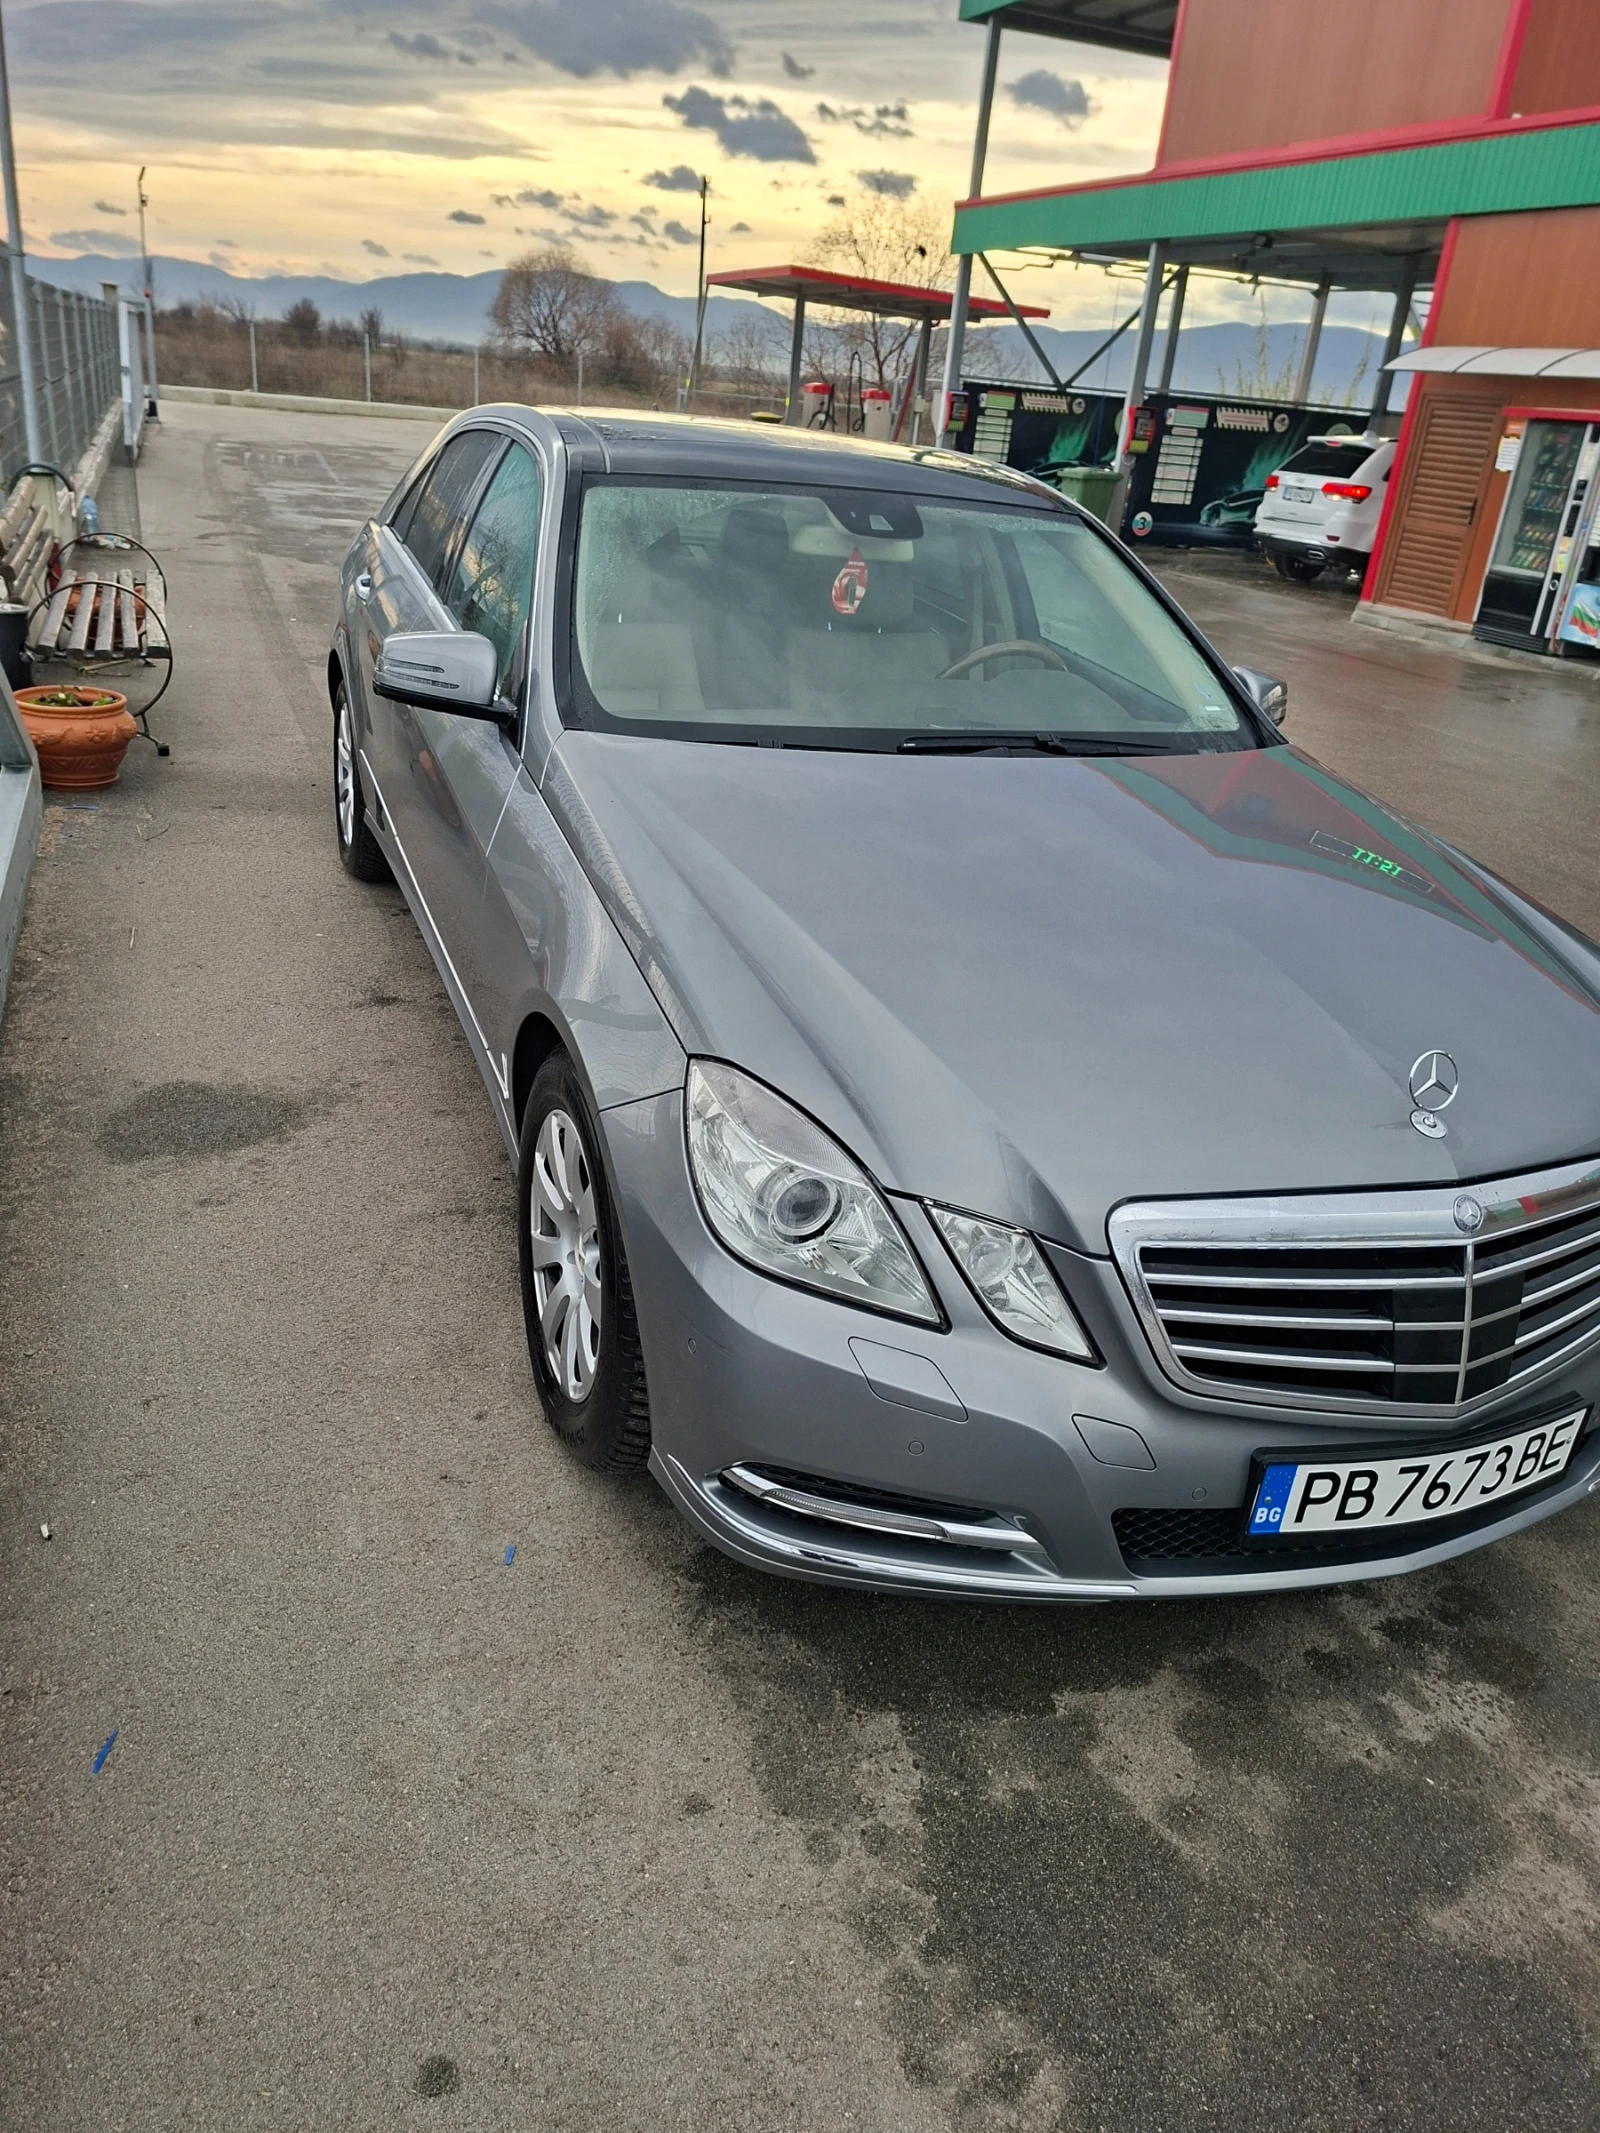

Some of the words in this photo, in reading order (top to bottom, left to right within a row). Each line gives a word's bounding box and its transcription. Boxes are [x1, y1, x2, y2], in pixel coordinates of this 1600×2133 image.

[1294, 1471, 1379, 1523] PB
[1385, 1445, 1513, 1517] 7673
[1512, 1418, 1576, 1484] BE
[1255, 1507, 1281, 1523] BG
